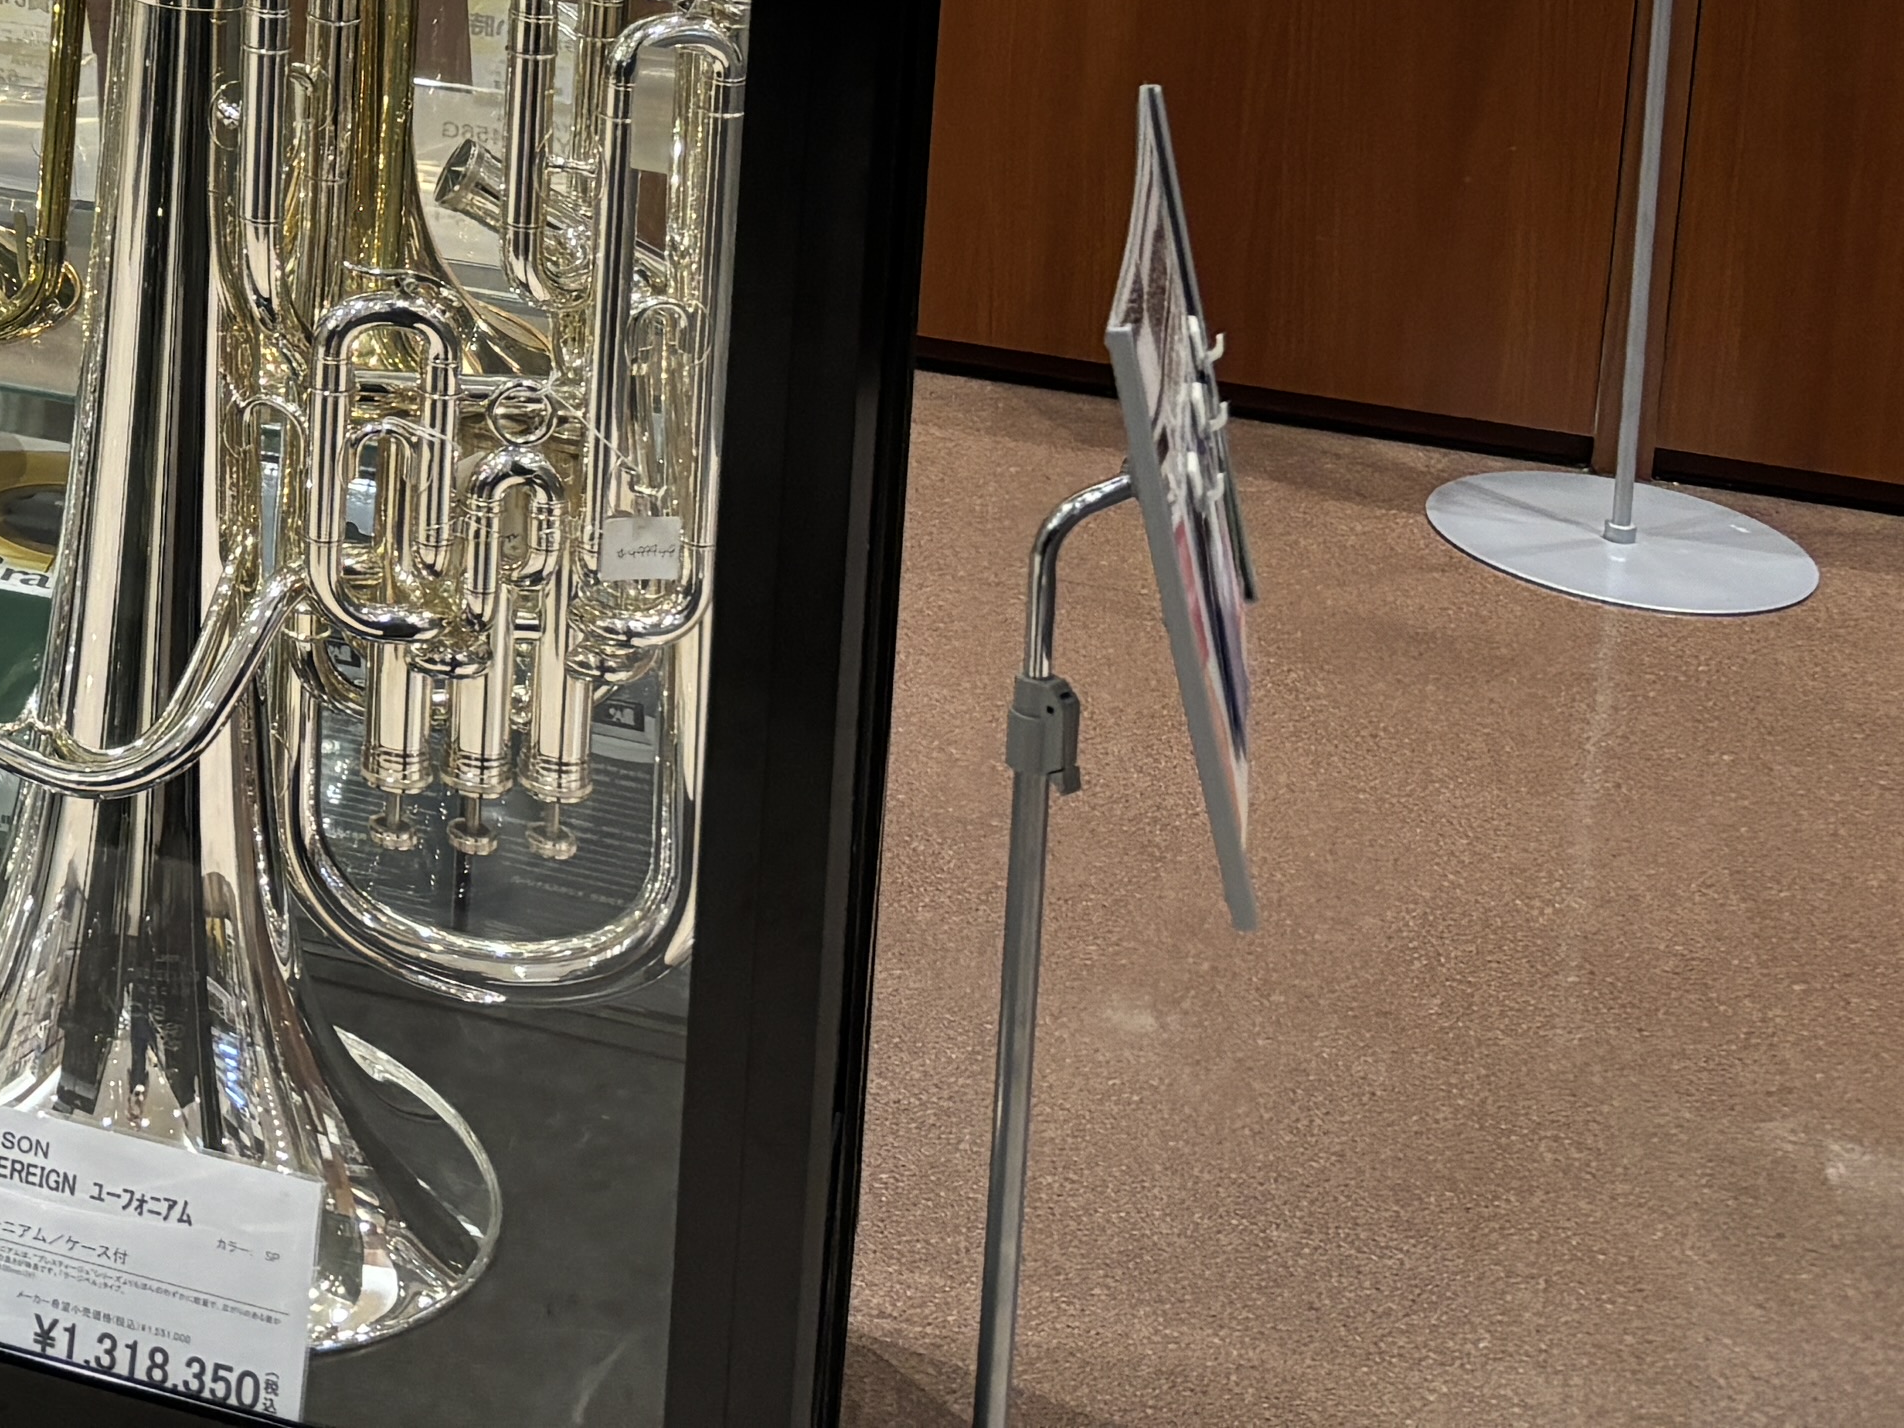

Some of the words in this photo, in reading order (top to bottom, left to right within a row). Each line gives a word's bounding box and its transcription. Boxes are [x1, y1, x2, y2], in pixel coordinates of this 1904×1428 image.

[89, 1181, 193, 1227] ユーフォニアム
[32, 1313, 260, 1412] ¥1,318,350
